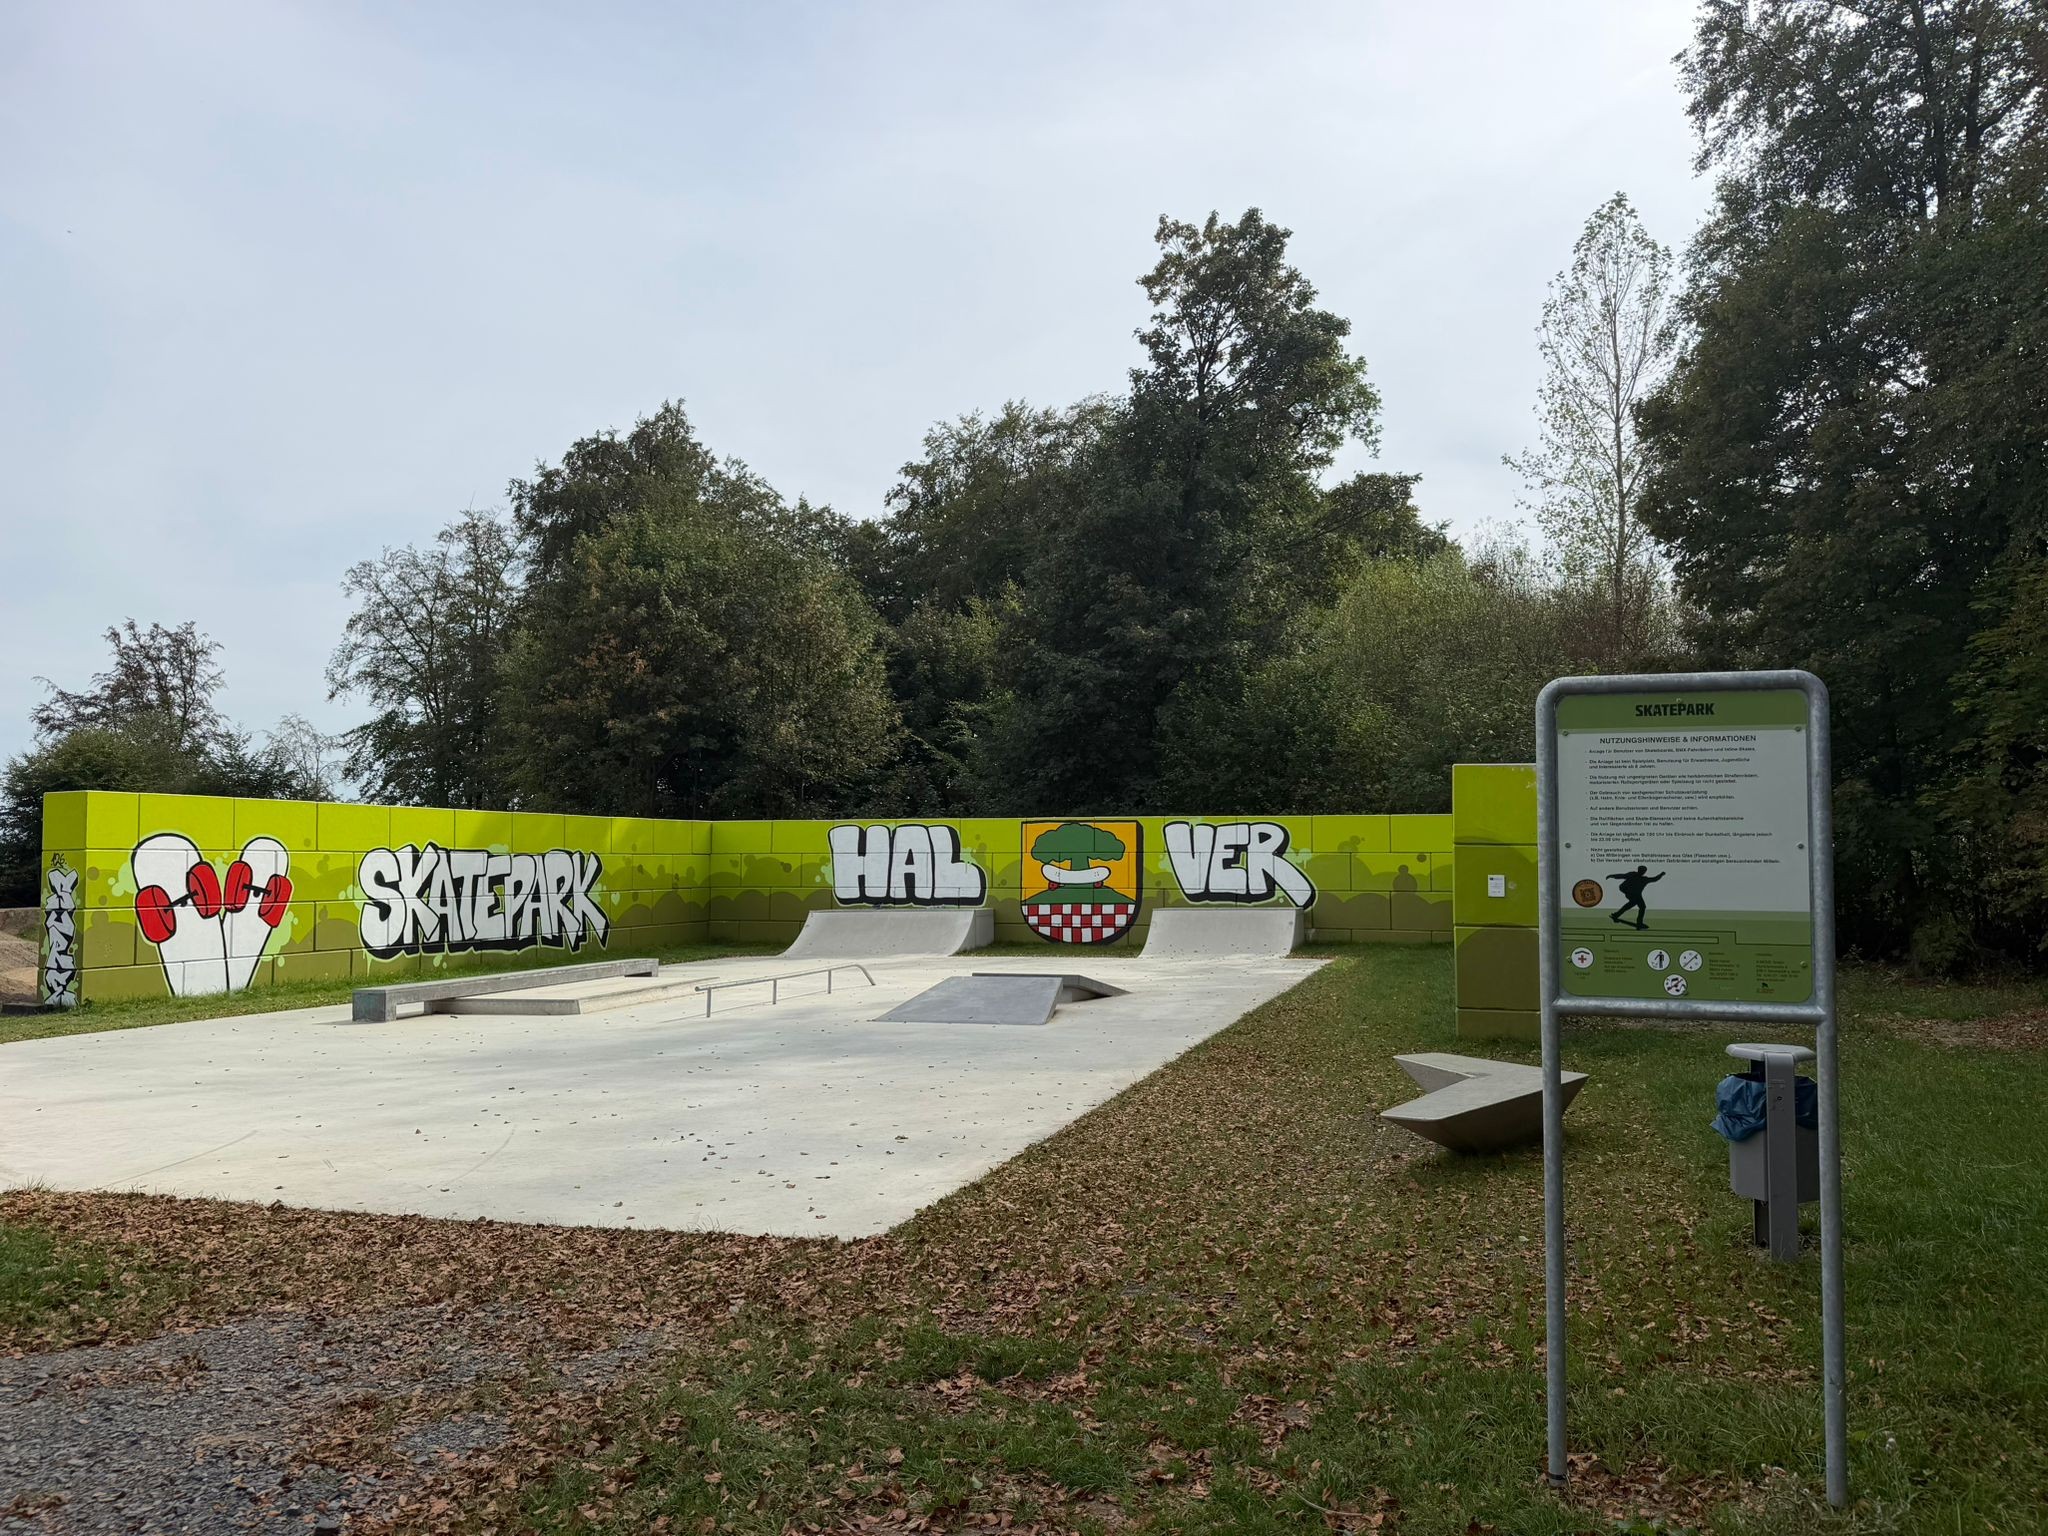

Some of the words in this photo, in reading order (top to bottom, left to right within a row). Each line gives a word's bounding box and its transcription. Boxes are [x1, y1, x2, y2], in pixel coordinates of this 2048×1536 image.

[1636, 703, 1714, 716] SKATEPARK
[1600, 737, 1681, 745] NUTZUNGSHINWEISE
[1683, 736, 1688, 744] &
[1690, 735, 1756, 743] INFORMATIONEN
[829, 825, 986, 906] HAL
[1163, 822, 1315, 907] VER
[358, 842, 610, 959] SKATEPARK
